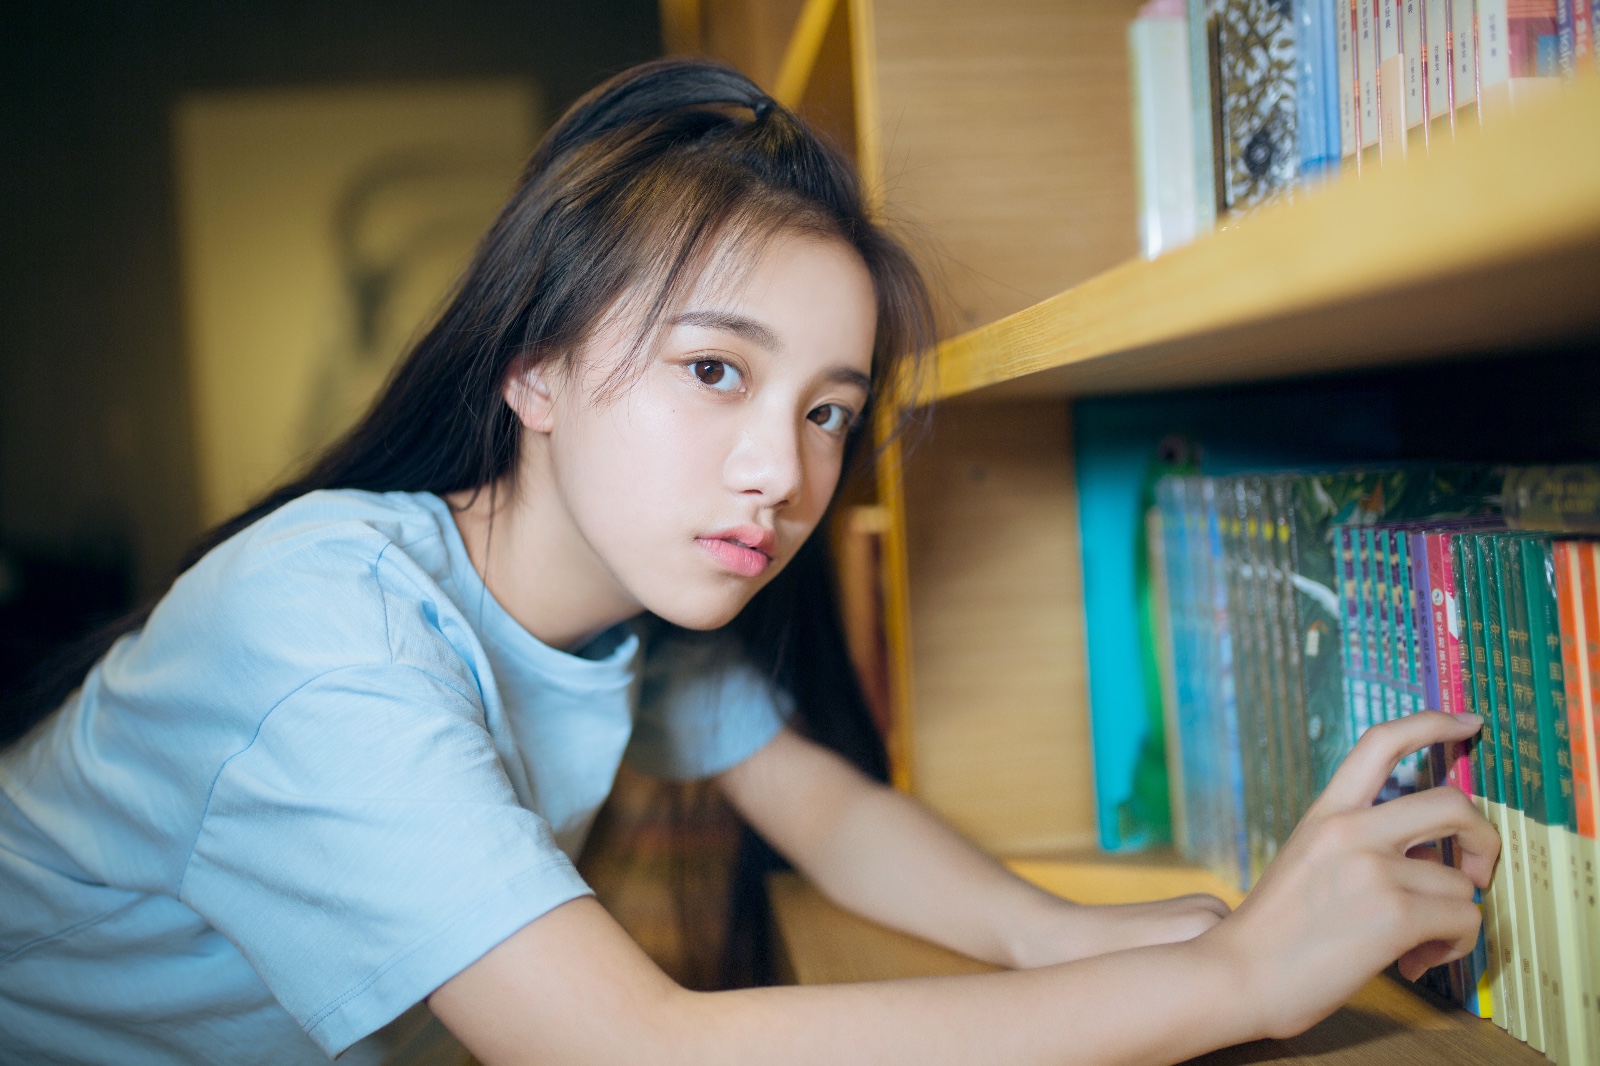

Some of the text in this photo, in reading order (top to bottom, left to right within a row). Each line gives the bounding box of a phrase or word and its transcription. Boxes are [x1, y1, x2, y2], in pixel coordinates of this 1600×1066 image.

[1457, 619, 1478, 763] 中国传说事
[1472, 620, 1495, 770] 中国传说故事
[1490, 623, 1513, 776] 中国传说故事
[1508, 627, 1532, 786] 中国传说故事
[1518, 629, 1542, 790] 中国传说故事
[1546, 633, 1572, 797] 中国传说故事
